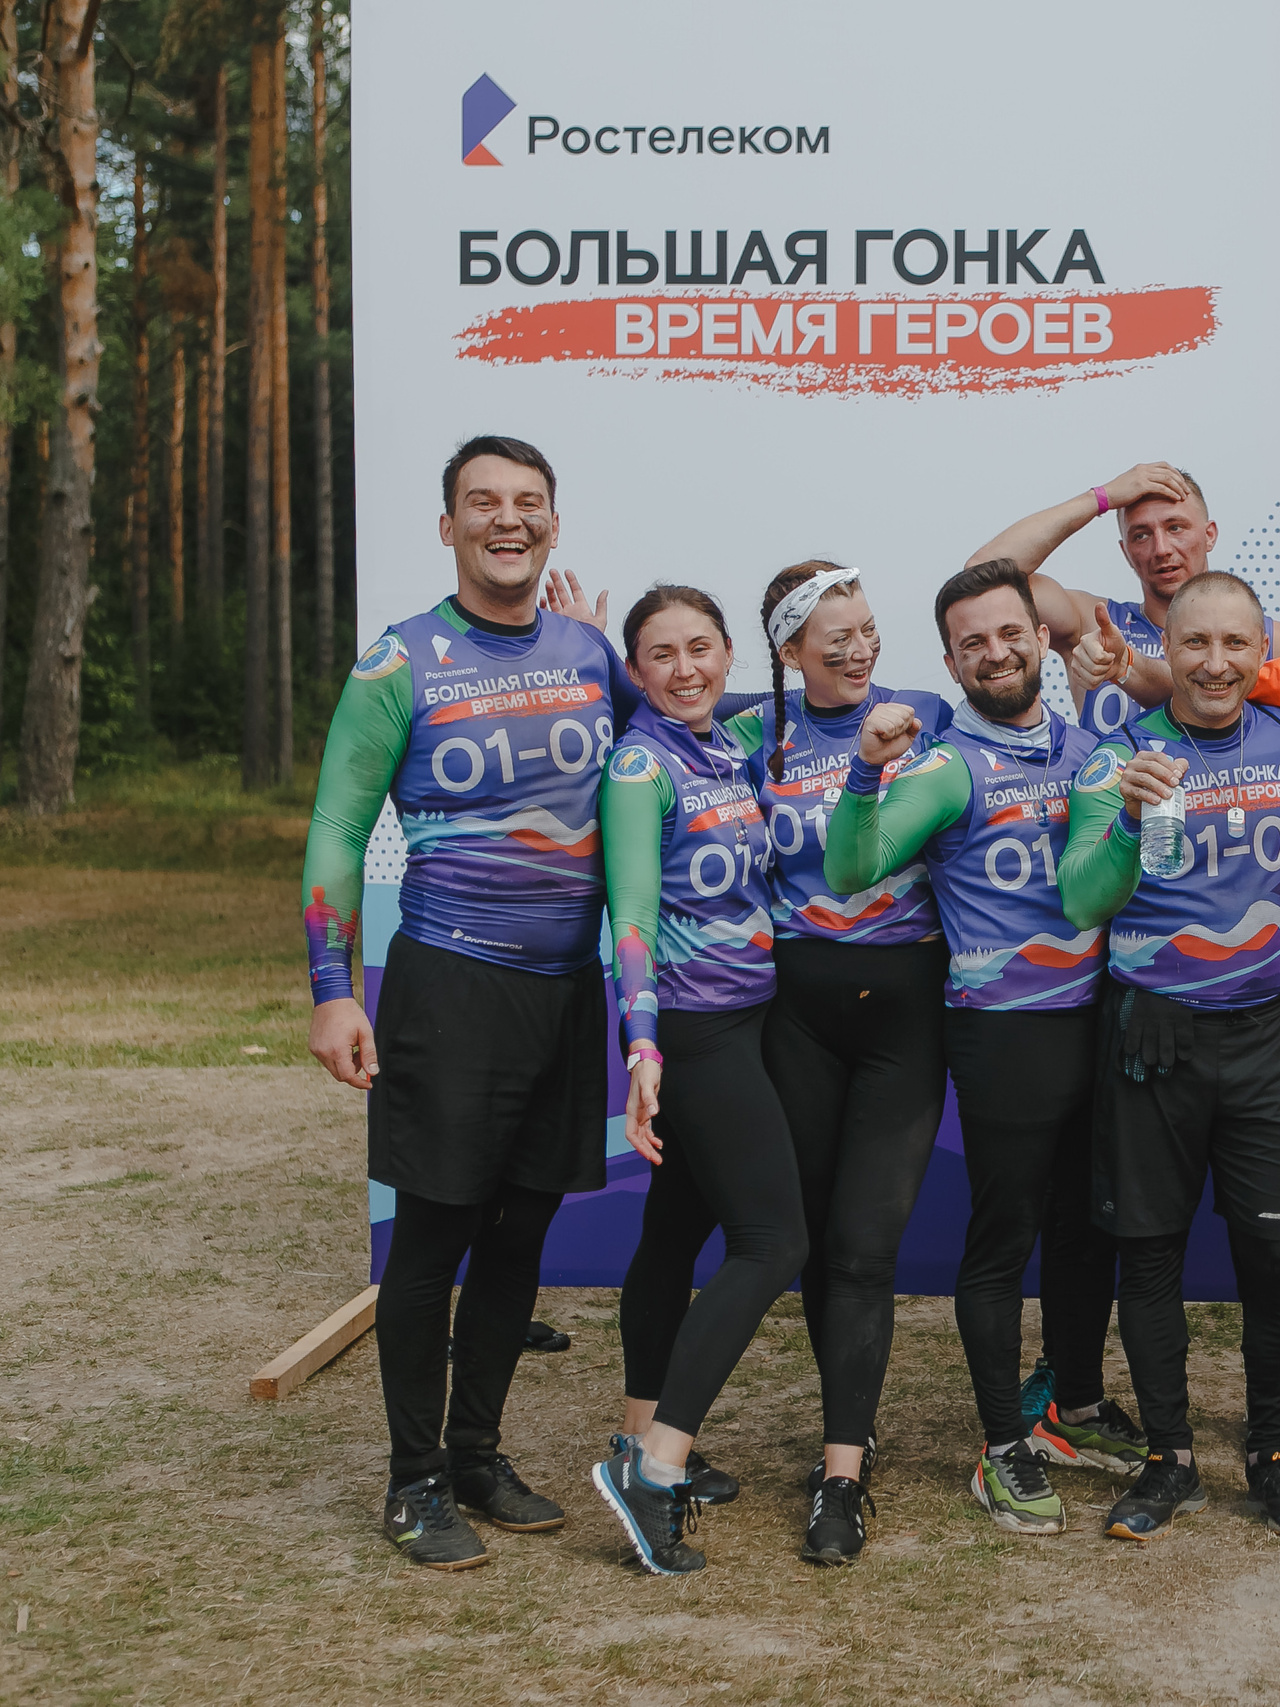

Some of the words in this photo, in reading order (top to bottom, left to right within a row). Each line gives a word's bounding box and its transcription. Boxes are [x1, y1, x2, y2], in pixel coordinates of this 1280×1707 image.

[527, 115, 831, 155] Ростелеком
[459, 229, 828, 287] БОЛЬШАЯ
[854, 229, 1106, 285] ГОНКА
[615, 303, 837, 356] ВРЕМЯ
[859, 302, 1114, 355] ГЕРОЕВ
[424, 674, 521, 705] БОЛЬШАЯ
[523, 668, 581, 688] ГОНКА
[425, 666, 478, 680] Ростелеком
[471, 694, 529, 715] ВРЕМЯ
[530, 688, 588, 706] ГЕРОЕВ
[431, 716, 614, 793] 01-08
[768, 752, 850, 783] ОЛЬШАЯ
[784, 749, 813, 763] телеком
[802, 767, 852, 793] ВРЕМЯ
[984, 773, 1024, 785] Ростелеком
[1183, 769, 1231, 791] ЬШАЯ
[682, 786, 732, 814] БОЛЬШАЯ
[984, 781, 1060, 809] БОЛЬШАЯ
[1185, 789, 1236, 811] ВРЕМЯ
